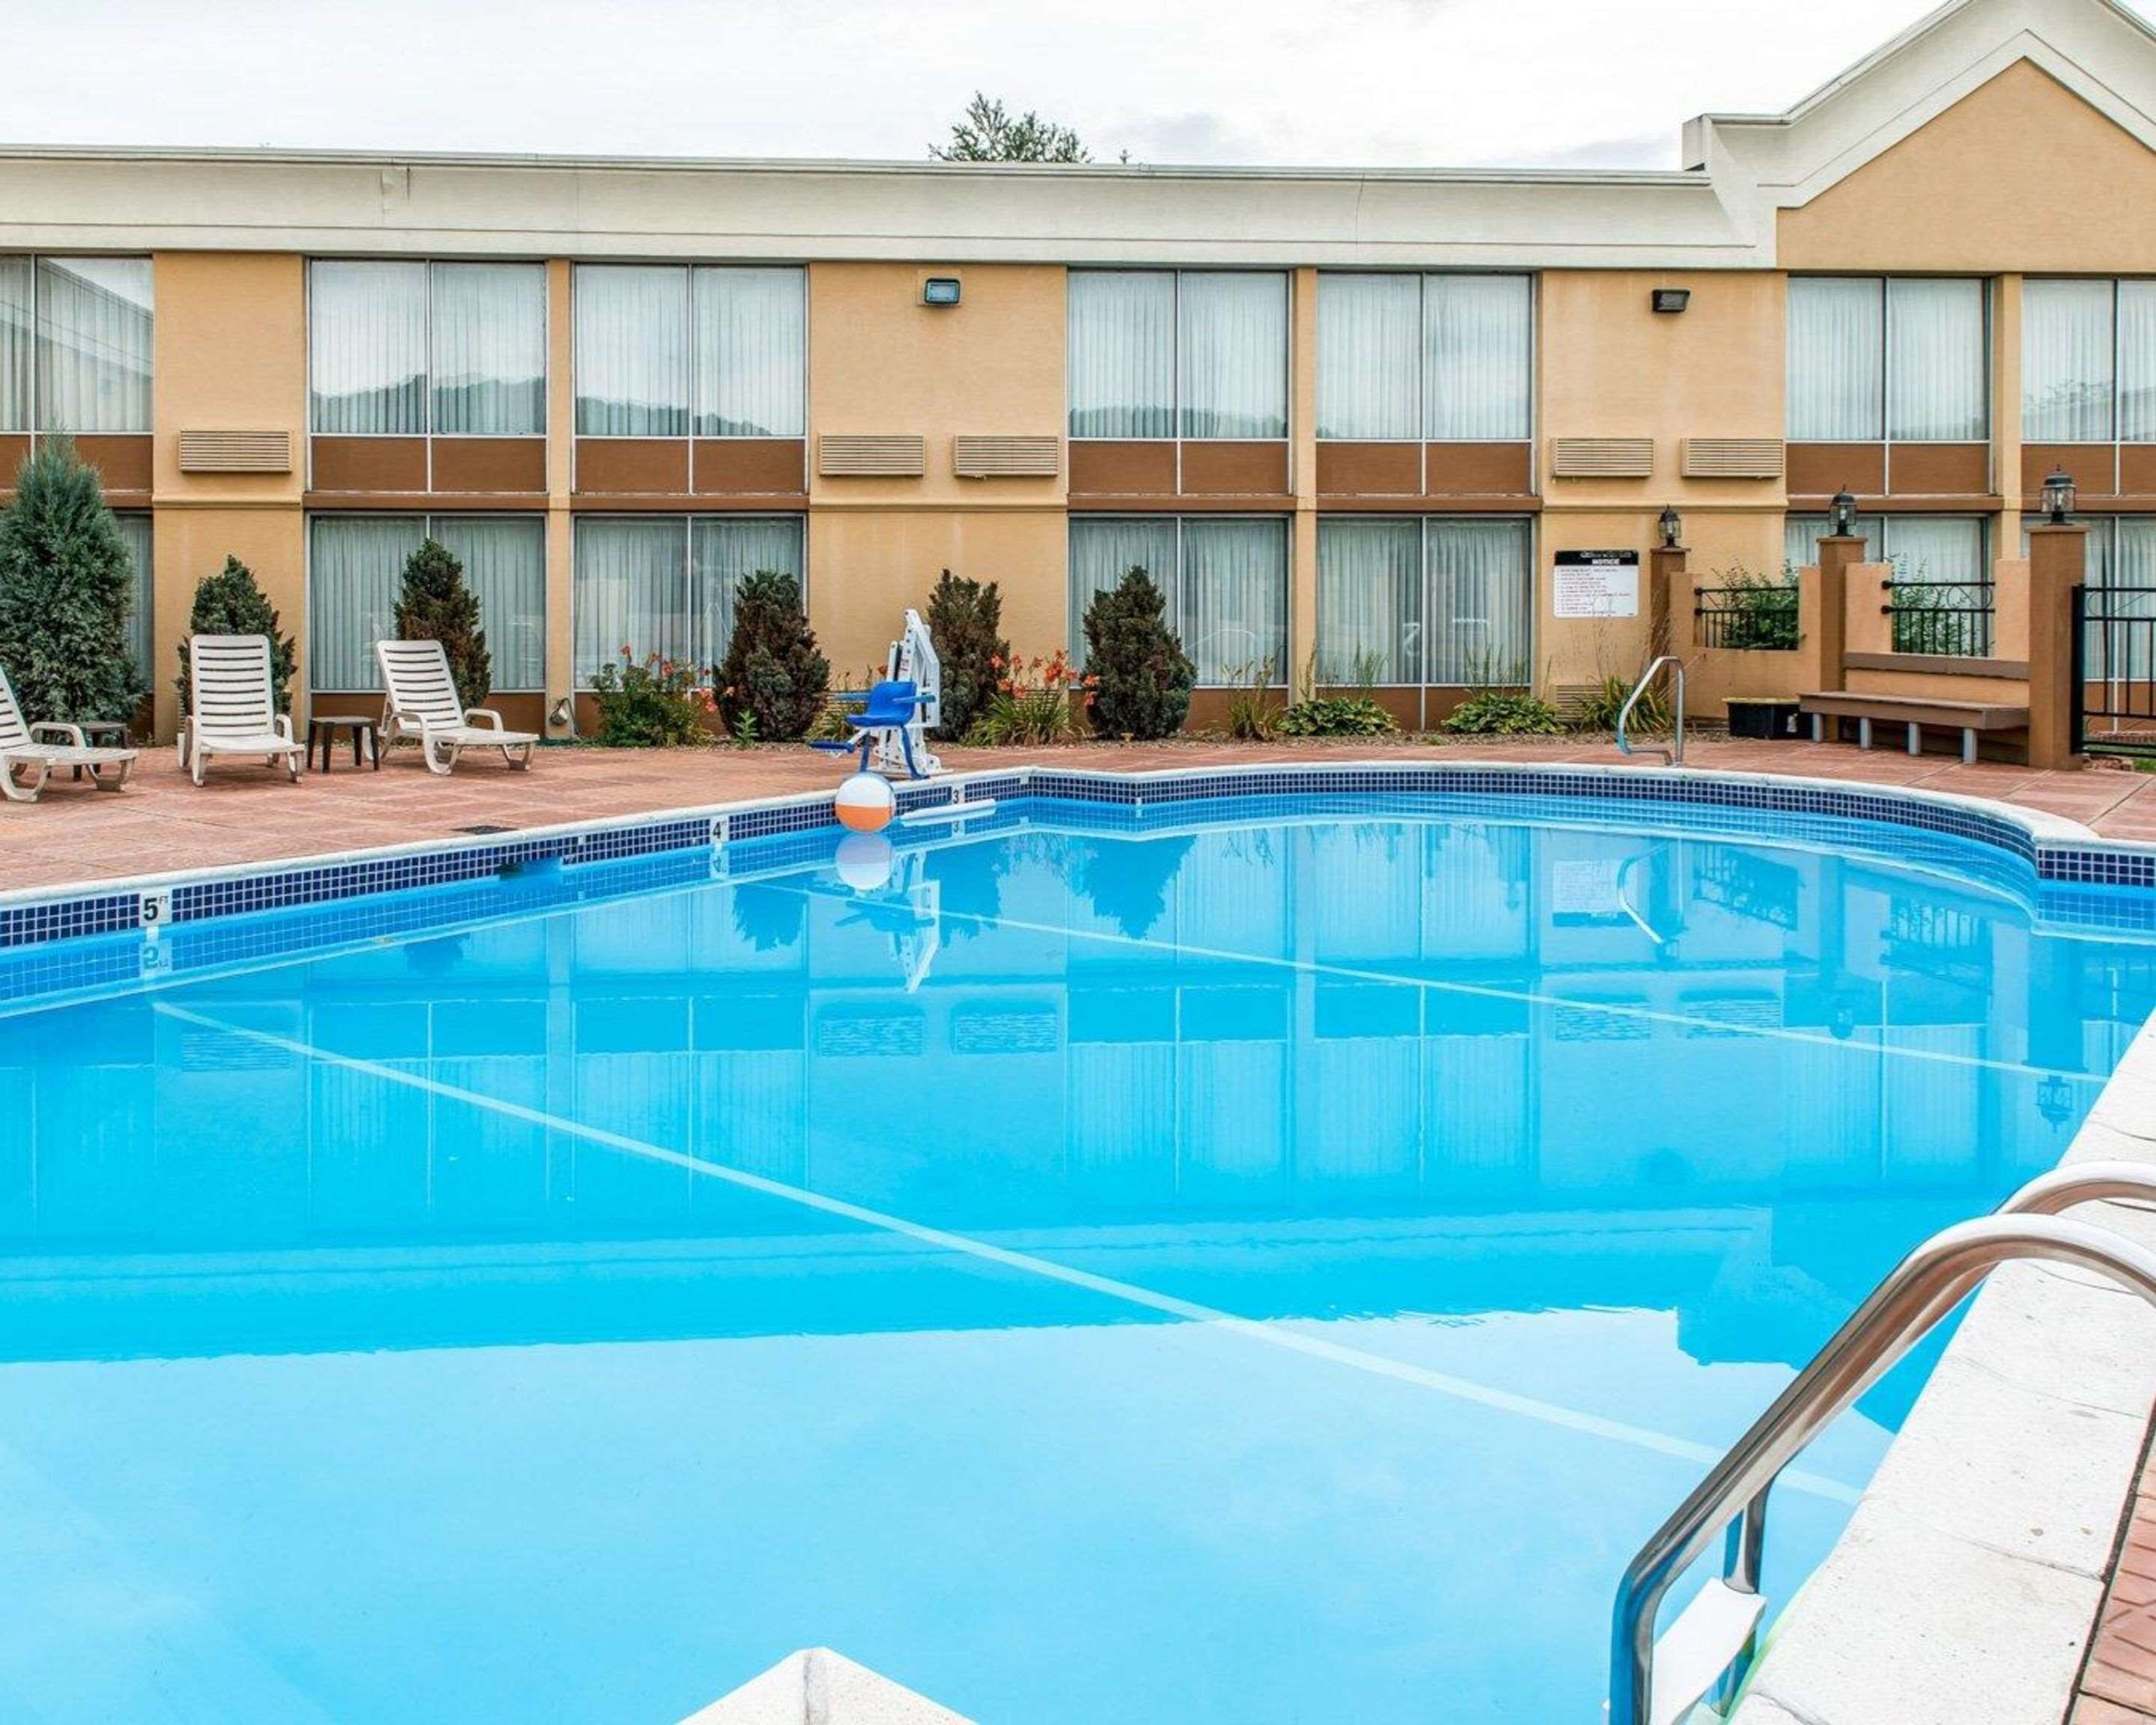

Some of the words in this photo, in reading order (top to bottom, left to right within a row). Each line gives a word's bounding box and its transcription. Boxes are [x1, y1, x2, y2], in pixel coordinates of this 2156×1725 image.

[953, 789, 959, 804] 3
[713, 821, 722, 839] 4
[143, 897, 159, 921] 5
